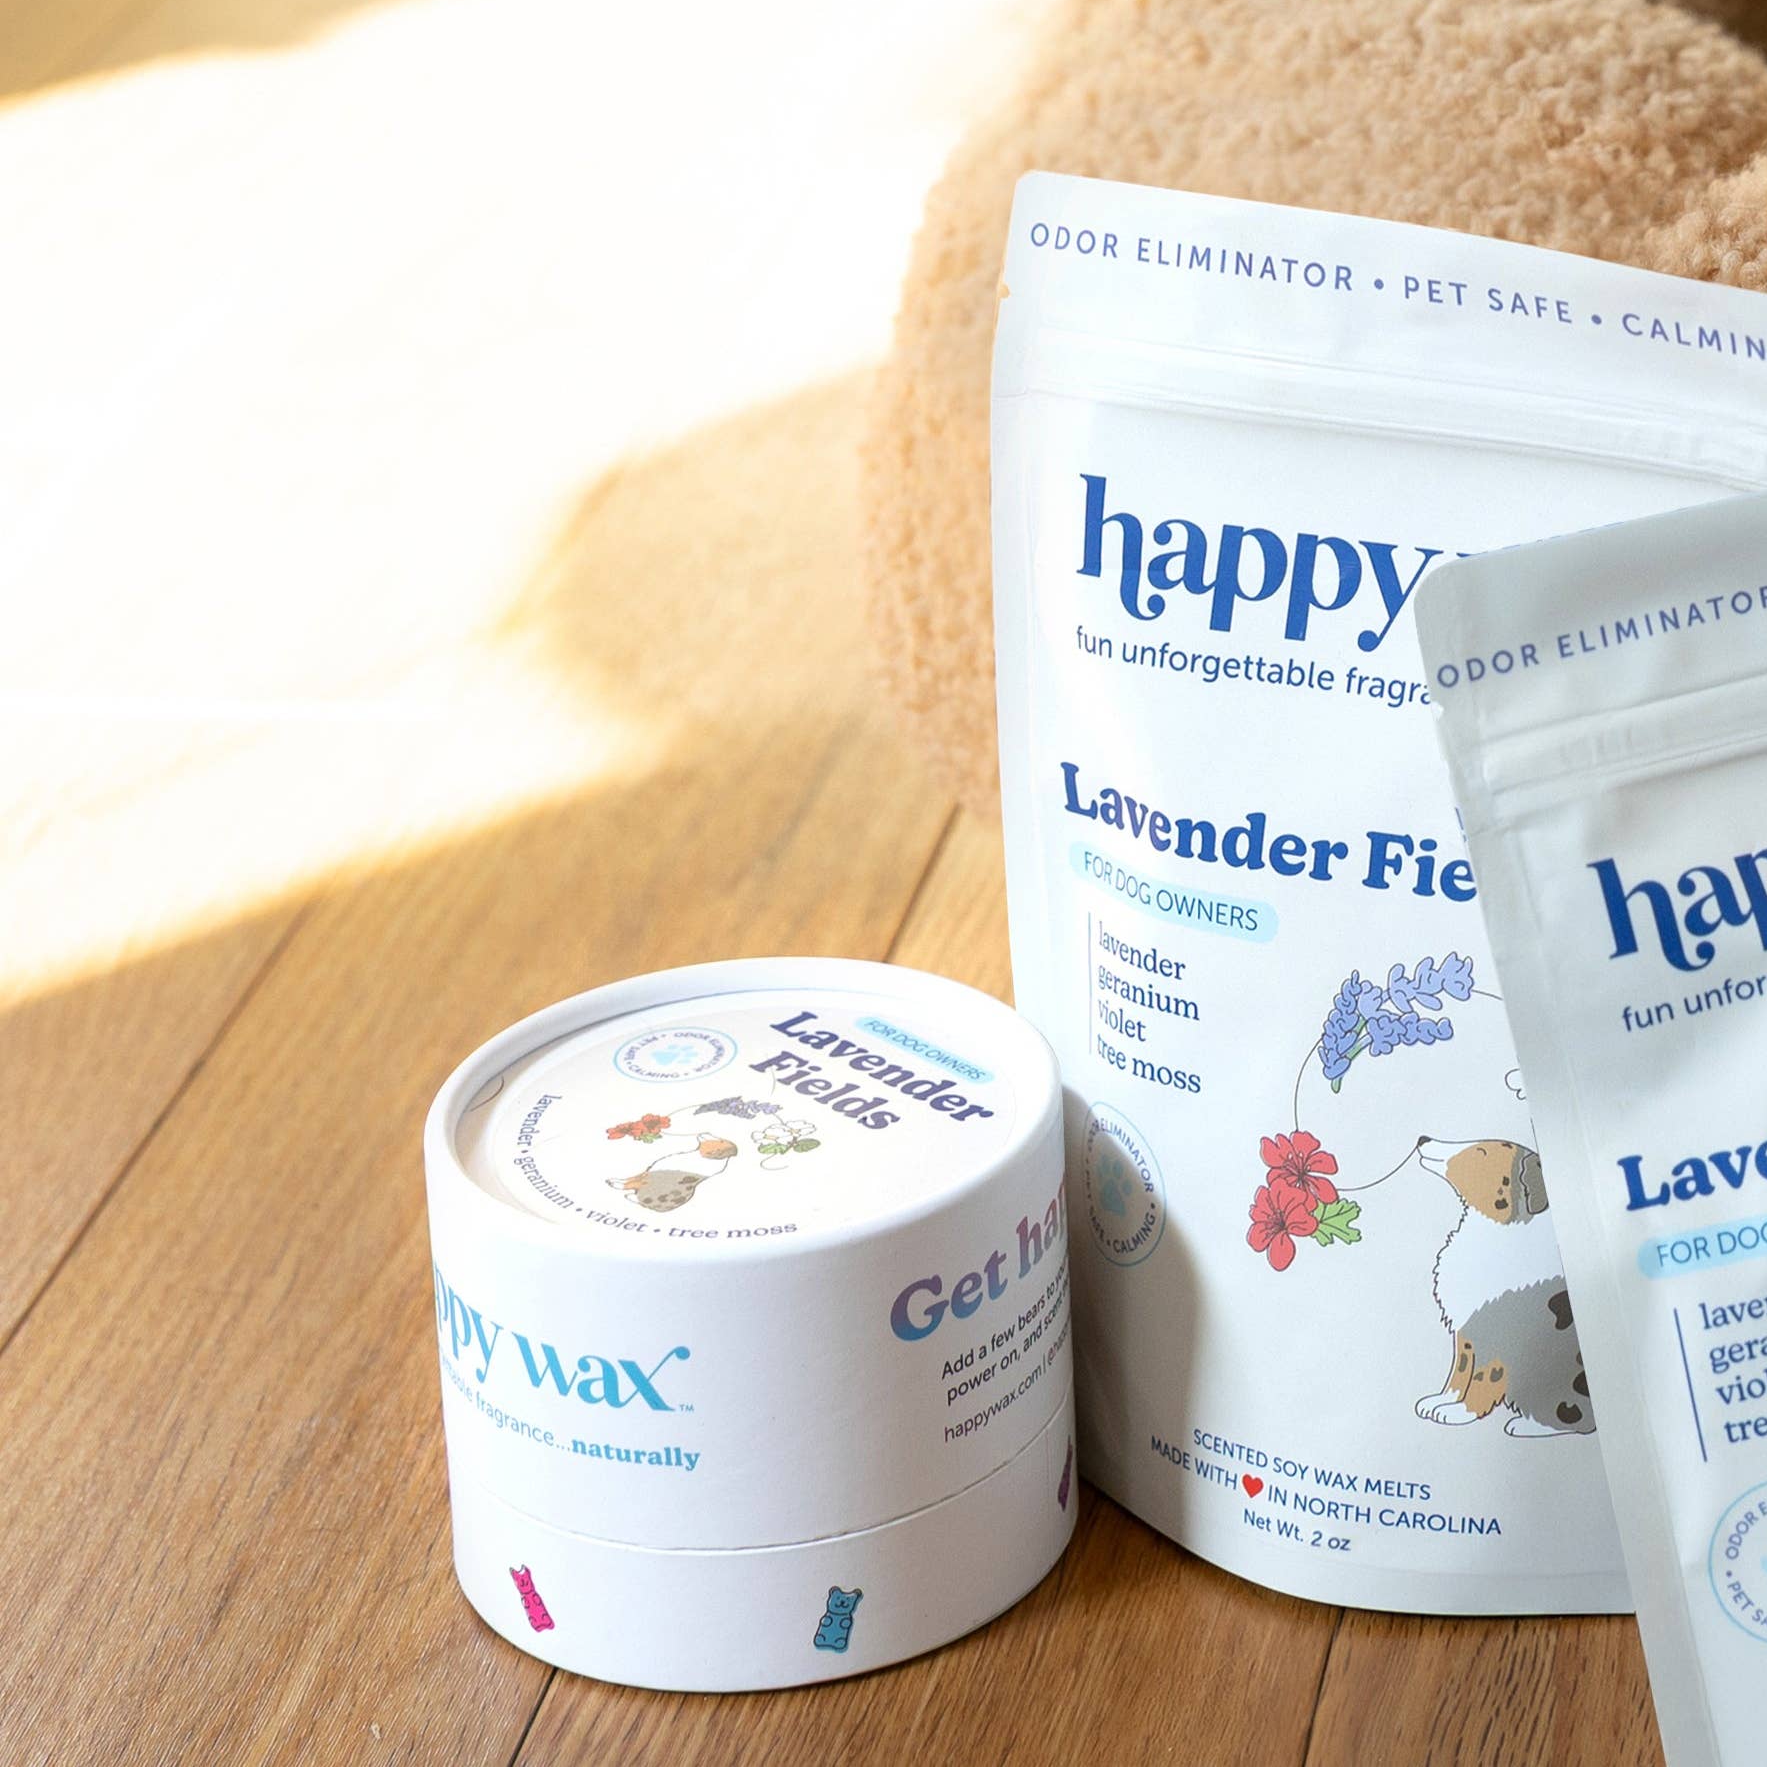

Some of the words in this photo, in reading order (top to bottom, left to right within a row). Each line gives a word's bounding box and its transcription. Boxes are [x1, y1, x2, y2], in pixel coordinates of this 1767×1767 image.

[1031, 223, 1118, 258] ODOR
[1137, 238, 1352, 291] ELIMINATOR
[1404, 276, 1468, 306] PET
[1488, 288, 1572, 323] SAFE
[1077, 473, 1444, 652] happy
[1076, 625, 1112, 659] fun
[1122, 642, 1335, 691] unforgettable
[1346, 667, 1431, 708] fragra
[1437, 644, 1539, 688] ODOR
[1060, 761, 1349, 881] Lavender
[1362, 825, 1477, 902] Fie
[1084, 851, 1112, 882] FOR
[1115, 867, 1152, 906] DOG
[1156, 889, 1258, 932] OWNERS
[1099, 921, 1186, 980] lavender
[1097, 999, 1147, 1042] violet
[1099, 965, 1200, 1021] geranium
[1622, 996, 1675, 1032] fun
[749, 1050, 901, 1129] Fields
[769, 1011, 995, 1121] Lavender
[925, 1049, 986, 1081] OWNERS
[1097, 1034, 1127, 1071] tree
[1132, 1056, 1201, 1094] moss
[517, 1094, 562, 1146] lavender
[513, 1156, 575, 1210] geranium
[586, 1206, 646, 1234] violet
[668, 1226, 718, 1239] tree
[726, 1222, 798, 1239] moss
[1112, 1212, 1156, 1255] CALMING
[1656, 1238, 1711, 1268] FOR
[890, 1249, 1008, 1342] Get
[435, 1259, 504, 1384] ppy
[511, 1332, 691, 1412] wax
[941, 1348, 975, 1380] Add
[978, 1344, 987, 1360] a
[990, 1322, 1022, 1353] few
[947, 1362, 997, 1406] power
[1000, 1346, 1021, 1370] on,
[1023, 1319, 1042, 1353] and
[1150, 1435, 1191, 1471] MADE
[1194, 1458, 1238, 1490] WITH
[1268, 1484, 1287, 1506] IN
[1294, 1492, 1371, 1524] NORTH
[1379, 1508, 1502, 1536] CAROLINA
[1193, 1428, 1268, 1468] SCENTED
[1272, 1456, 1309, 1481] SOY
[1314, 1467, 1359, 1493] WAX
[1364, 1477, 1431, 1501] MELTS
[1244, 1508, 1271, 1532] Net
[1277, 1520, 1304, 1543] Wt.
[1311, 1530, 1322, 1547] 2
[1328, 1536, 1351, 1552] oz
[1725, 1511, 1759, 1560] ODOR
[1727, 1580, 1754, 1610] PET
